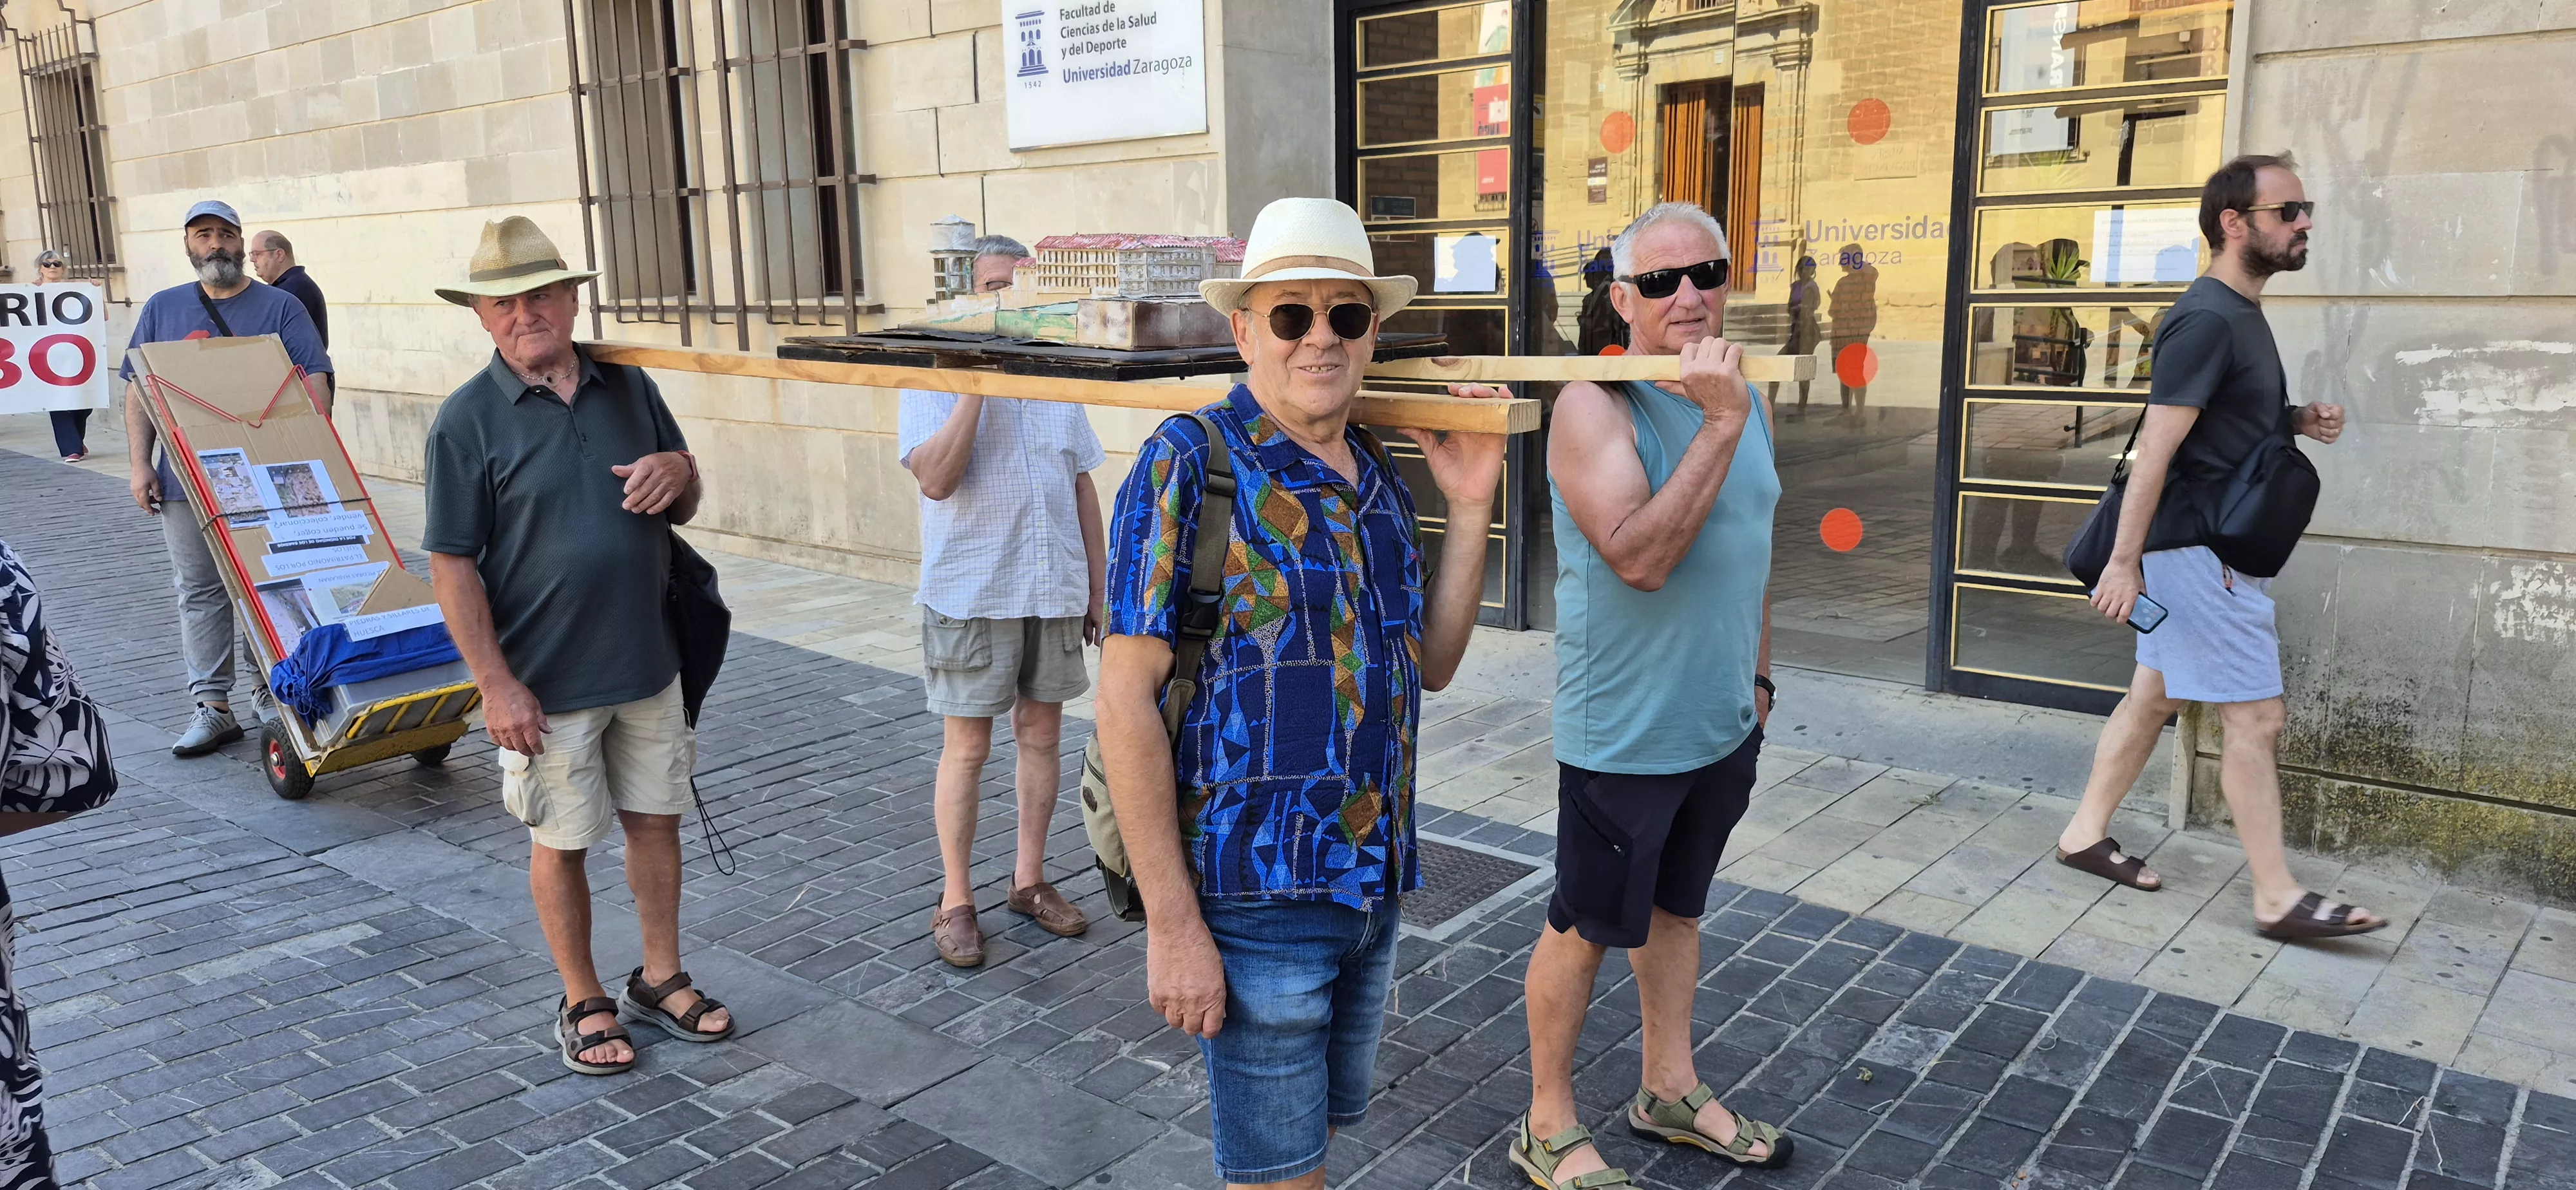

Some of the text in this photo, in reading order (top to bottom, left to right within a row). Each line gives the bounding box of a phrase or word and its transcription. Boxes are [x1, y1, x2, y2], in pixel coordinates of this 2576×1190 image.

[1059, 1, 1115, 21] Facultad de
[1061, 12, 1157, 39] Ciencias de la Salud
[1061, 39, 1127, 60] y del Deporte
[1063, 55, 1193, 84] Universidad Zaragoza
[1024, 80, 1042, 89] 1542
[1805, 215, 1949, 243] Universida
[1804, 249, 1902, 270] Zaragoza
[274, 513, 363, 529] vender, coleccionar?
[323, 524, 355, 534] pueden
[294, 528, 321, 536] coger,
[308, 555, 354, 565] PATRIMONIO
[349, 614, 381, 626] PIEDRAS
[388, 607, 420, 619] SILLARES
[354, 625, 385, 637] HUESCA
